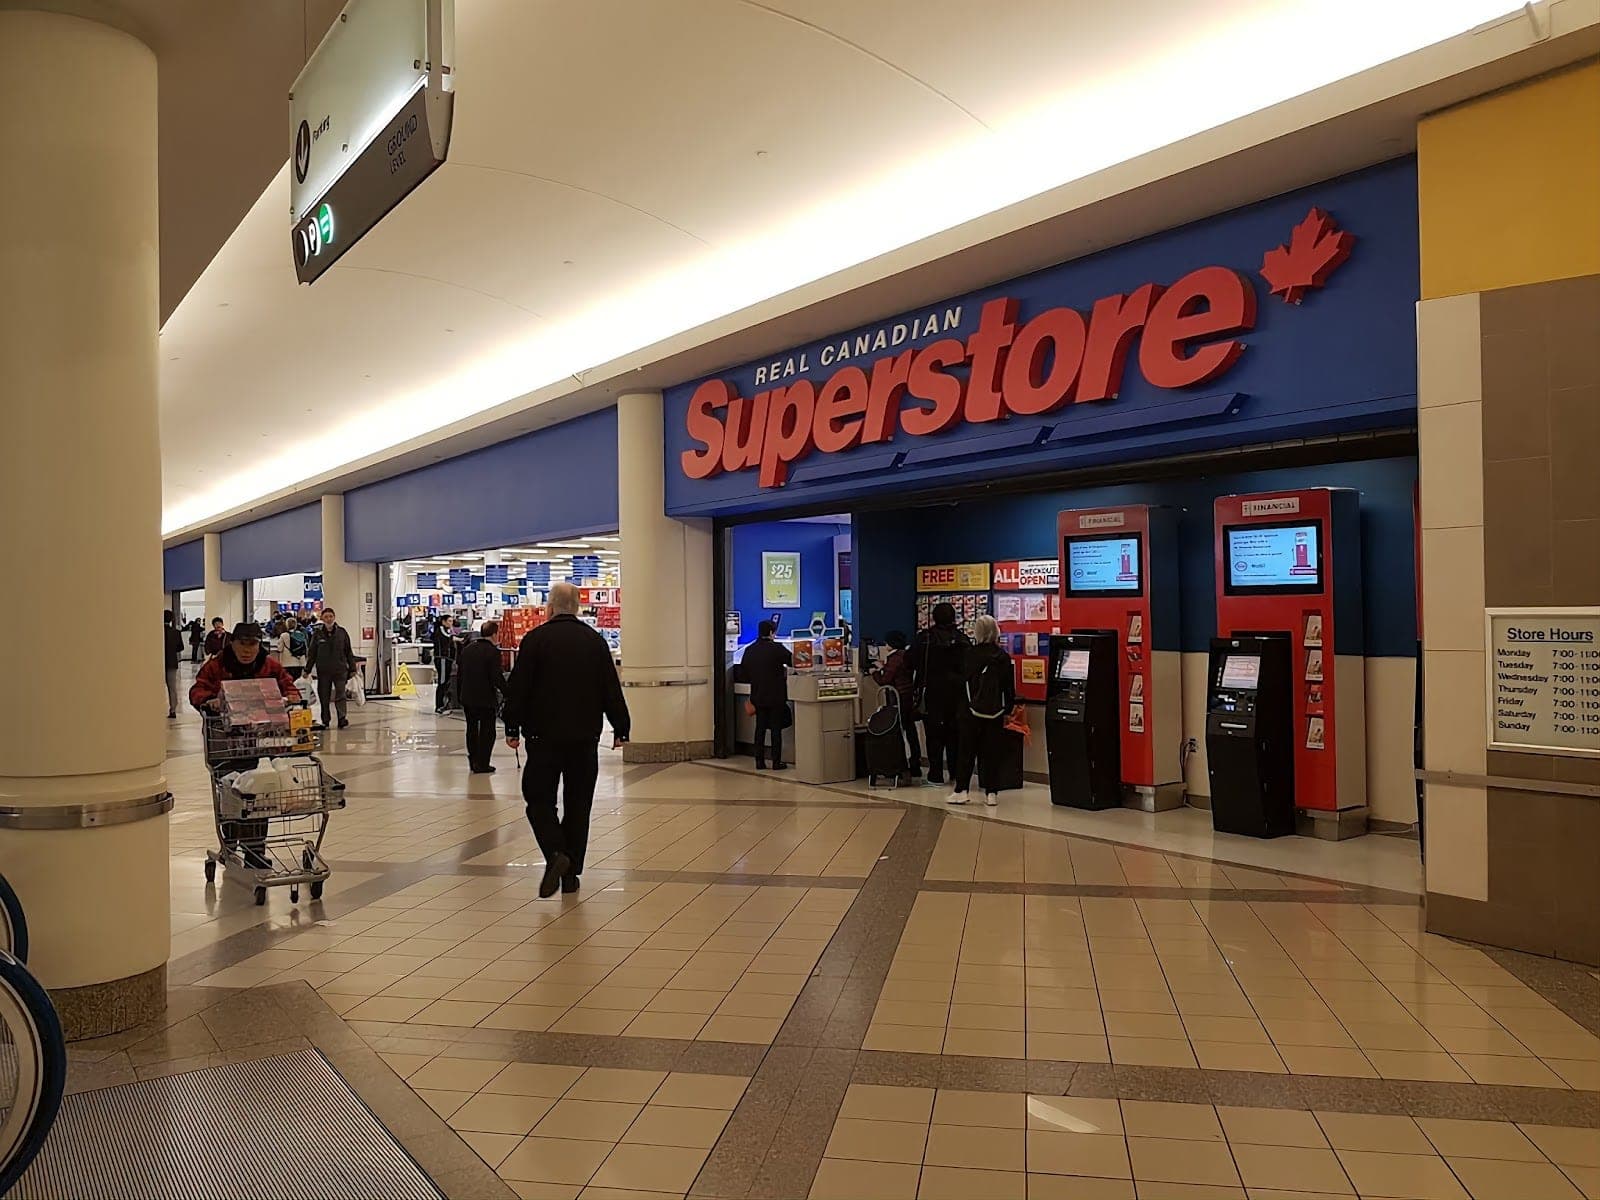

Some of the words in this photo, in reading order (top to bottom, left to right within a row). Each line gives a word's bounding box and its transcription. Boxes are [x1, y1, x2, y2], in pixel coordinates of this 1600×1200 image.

[388, 115, 418, 155] GROUND
[390, 152, 406, 174] LEVEL
[755, 354, 809, 386] REAL
[821, 306, 962, 366] CANADIAN
[681, 266, 1257, 488] Superstore
[922, 568, 955, 583] FREE
[994, 568, 1020, 584] ALL
[1020, 576, 1045, 585] OPEN
[1507, 627, 1545, 640] Store
[1550, 628, 1593, 641] Hours
[1497, 648, 1531, 658] Monday
[1497, 660, 1534, 670] Tuesday
[1497, 672, 1549, 683] Wednesday
[1498, 684, 1538, 695] Thursday
[1498, 696, 1524, 707] Friday
[1498, 709, 1536, 720] Saturday
[1498, 720, 1530, 731] Sunday
